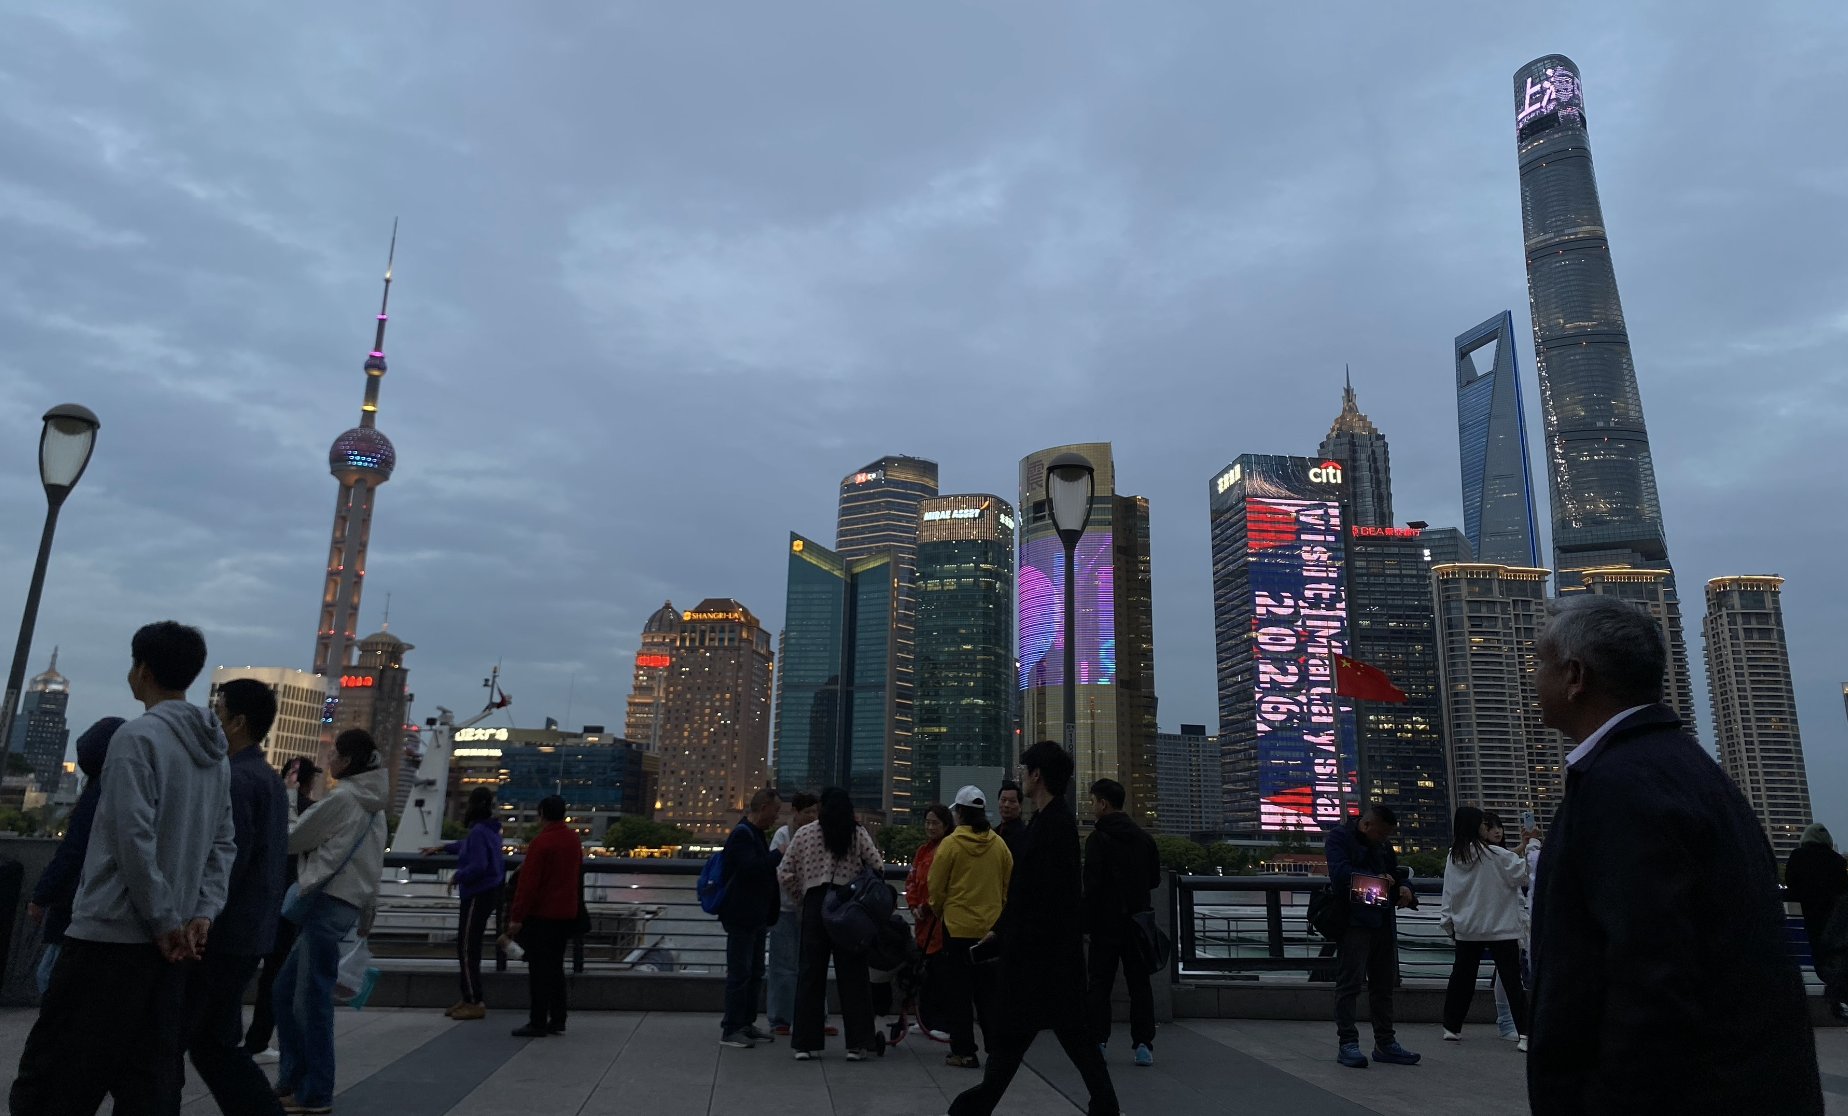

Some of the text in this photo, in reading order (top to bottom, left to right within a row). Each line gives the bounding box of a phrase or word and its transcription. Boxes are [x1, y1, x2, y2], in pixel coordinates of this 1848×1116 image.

[1309, 464, 1342, 484] citi
[923, 508, 981, 521] MIRAE ASSET
[691, 611, 739, 621] SHANGRI-LA
[1255, 591, 1300, 721] 2026
